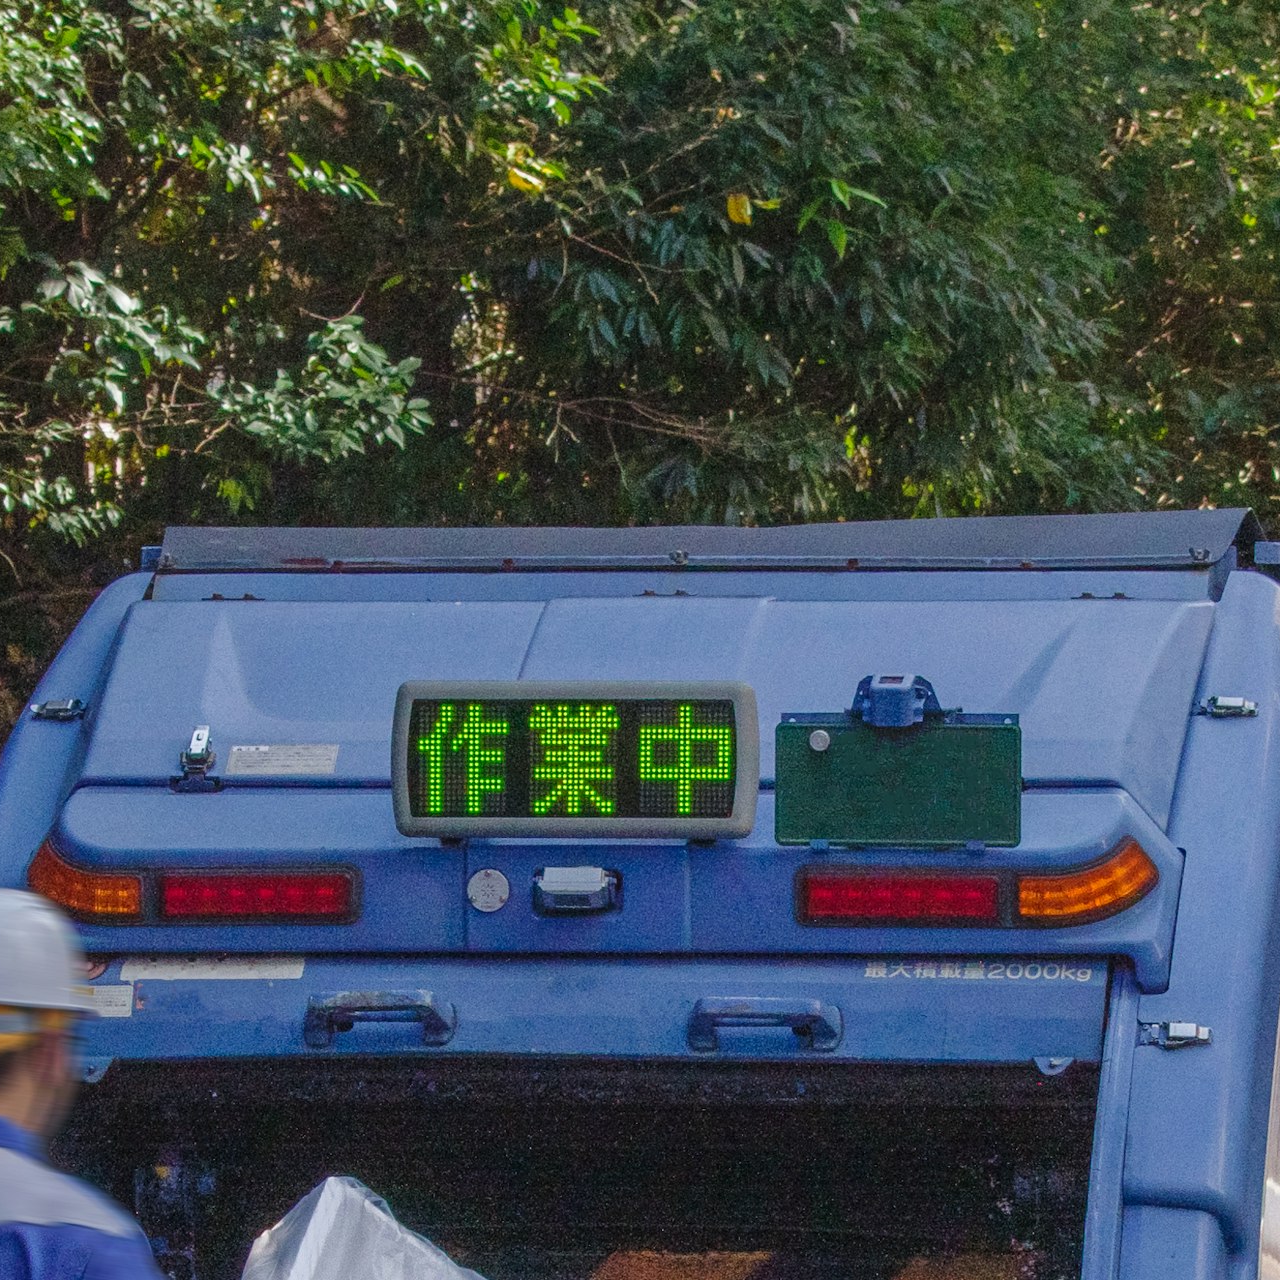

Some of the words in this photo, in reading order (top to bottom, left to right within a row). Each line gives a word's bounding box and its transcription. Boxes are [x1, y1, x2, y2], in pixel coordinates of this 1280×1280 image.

[418, 704, 731, 814] 作業中
[863, 962, 1092, 982] 最大積載量2000kg
